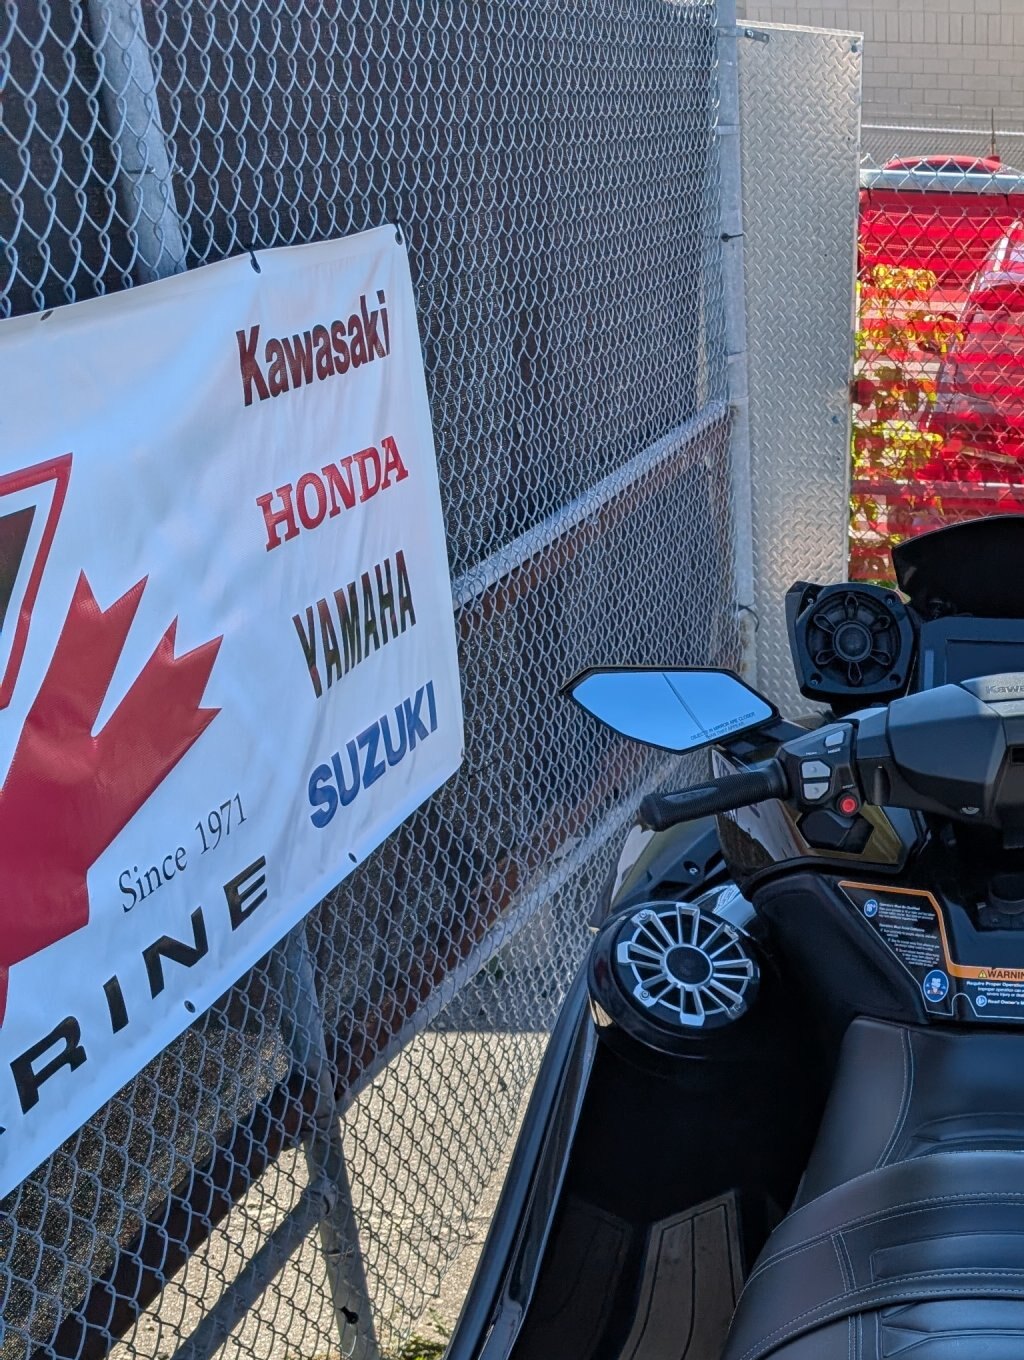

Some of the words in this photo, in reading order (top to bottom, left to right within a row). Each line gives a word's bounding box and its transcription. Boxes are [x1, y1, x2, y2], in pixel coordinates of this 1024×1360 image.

[236, 290, 391, 406] Kawasaki
[256, 435, 408, 552] HONDA
[292, 549, 417, 698] YAMAHA
[308, 680, 438, 829] SUZUKI
[118, 847, 188, 912] Since
[194, 793, 247, 854] 1971
[0, 855, 268, 1137] RINE
